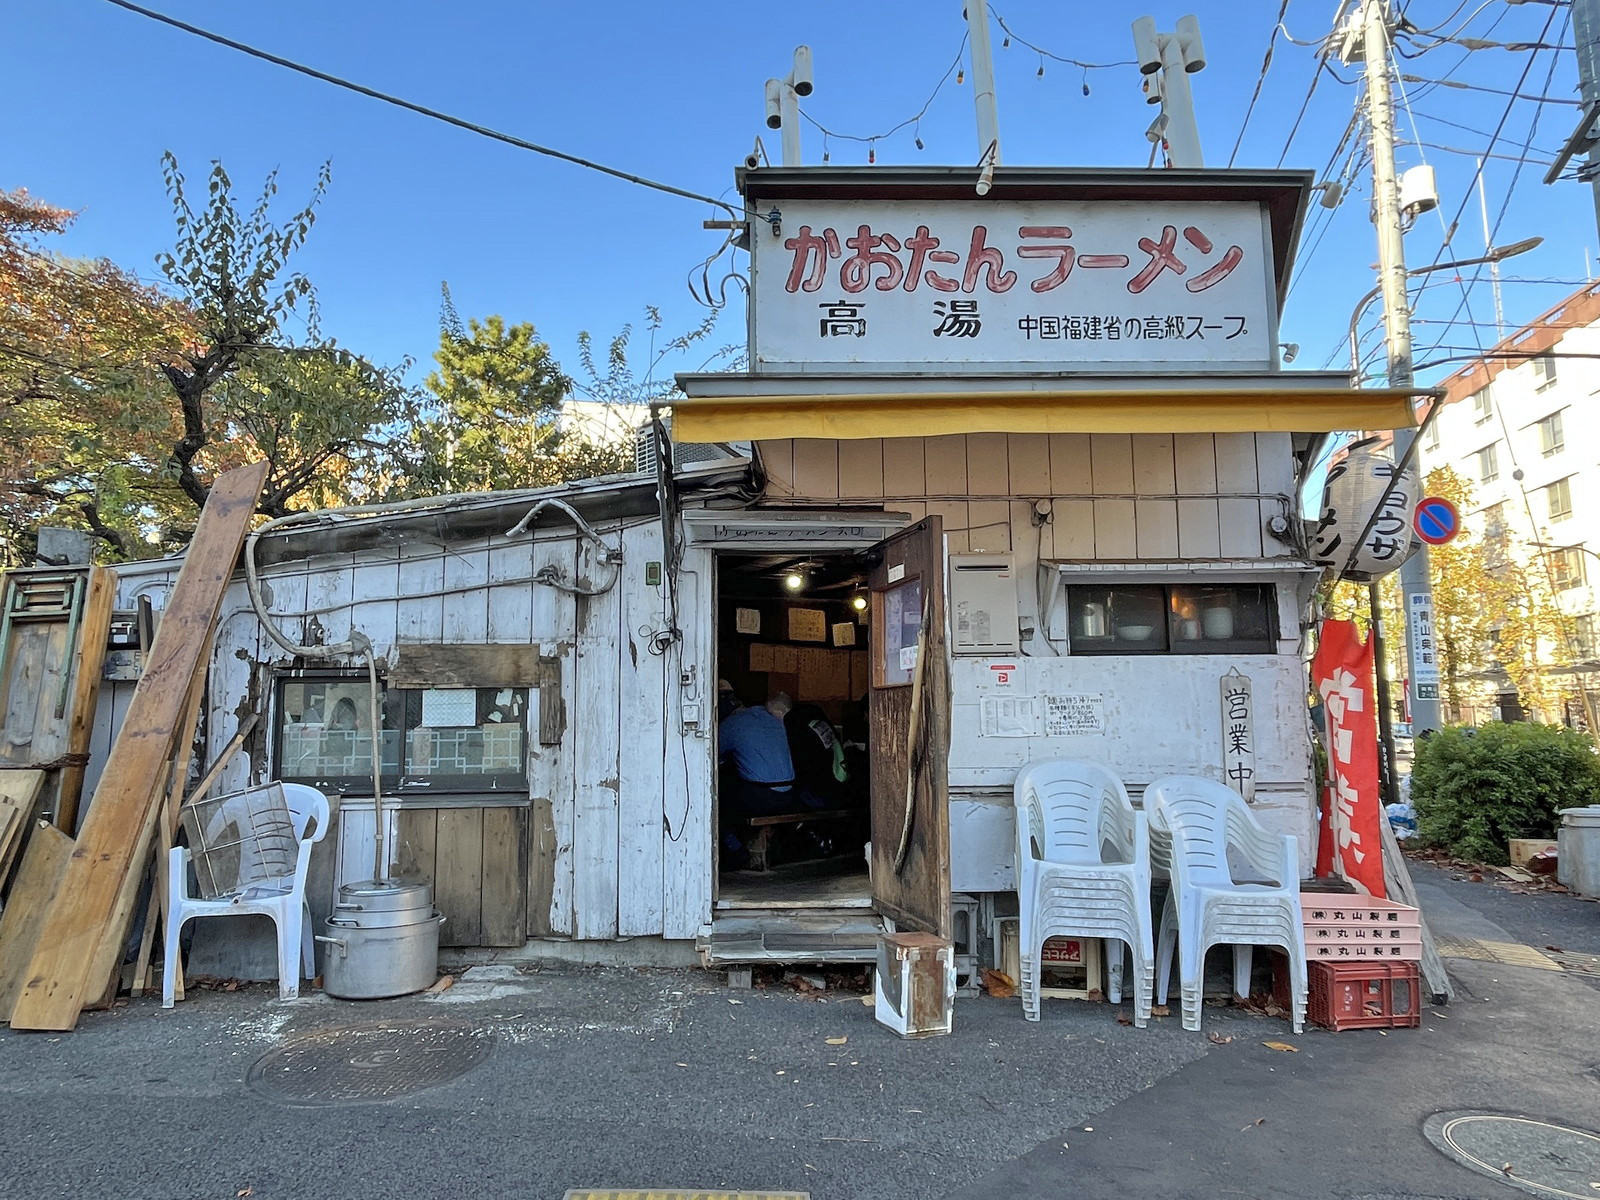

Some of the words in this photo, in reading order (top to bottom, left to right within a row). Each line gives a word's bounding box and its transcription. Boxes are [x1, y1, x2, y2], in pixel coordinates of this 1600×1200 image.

[784, 224, 1244, 294] かおたんラーメン
[1224, 687, 1253, 795] 営業中
